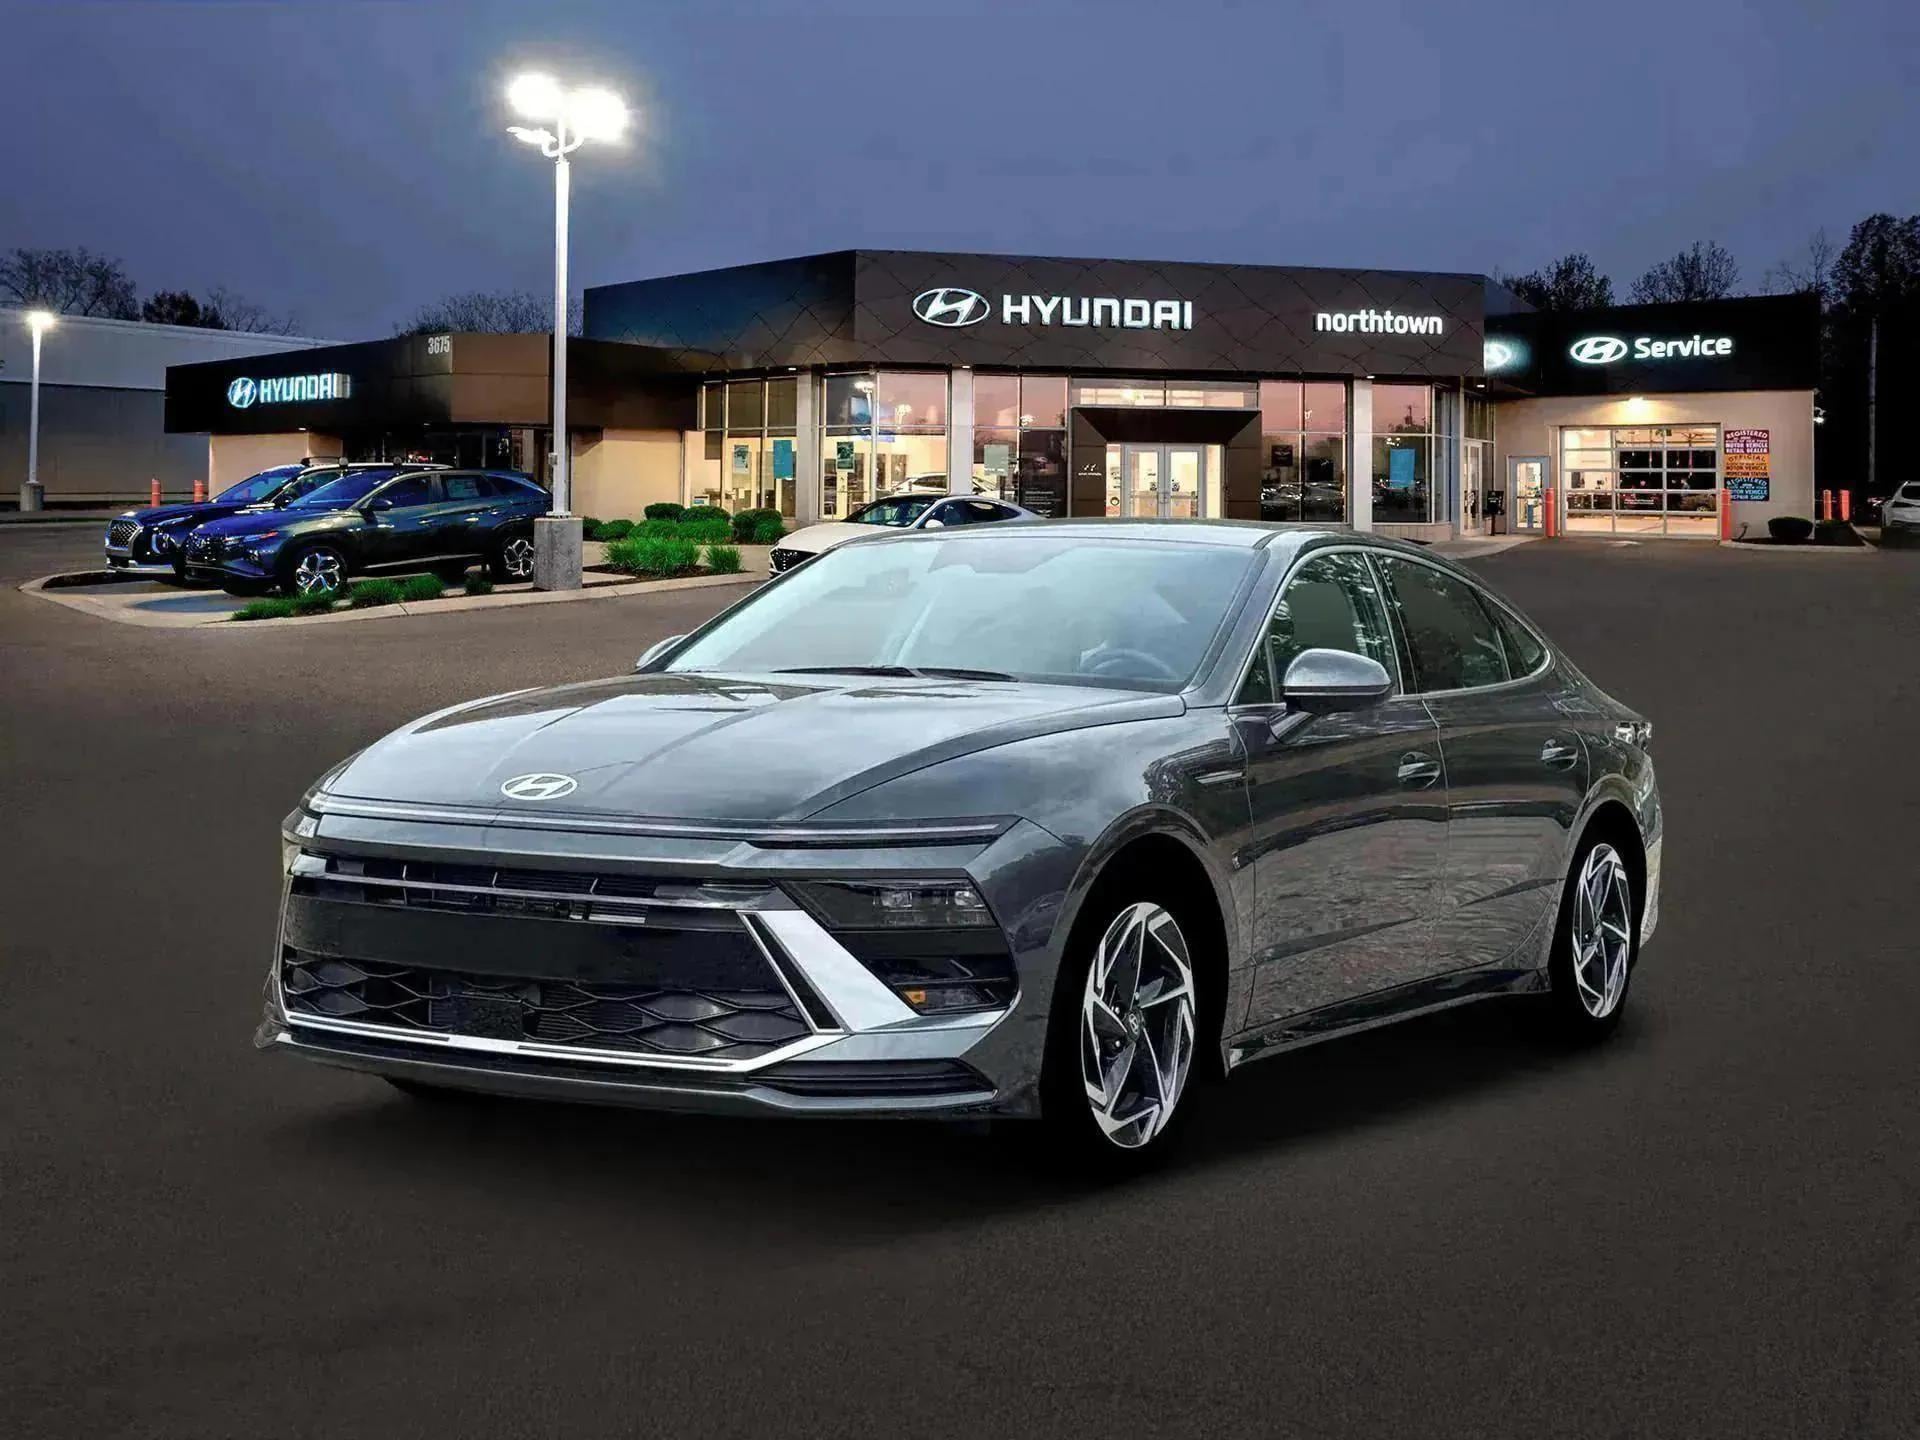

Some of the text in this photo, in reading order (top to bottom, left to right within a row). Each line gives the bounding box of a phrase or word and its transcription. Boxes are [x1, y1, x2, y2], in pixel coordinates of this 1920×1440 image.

[1002, 294, 1193, 330] HYUNDAI
[1316, 310, 1443, 335] northtown
[428, 336, 450, 354] 3675
[1633, 336, 1732, 360] Service
[260, 372, 346, 403] HYUNDAI
[1726, 430, 1768, 439] REGISTERED
[1726, 477, 1768, 486] REGISTERED
